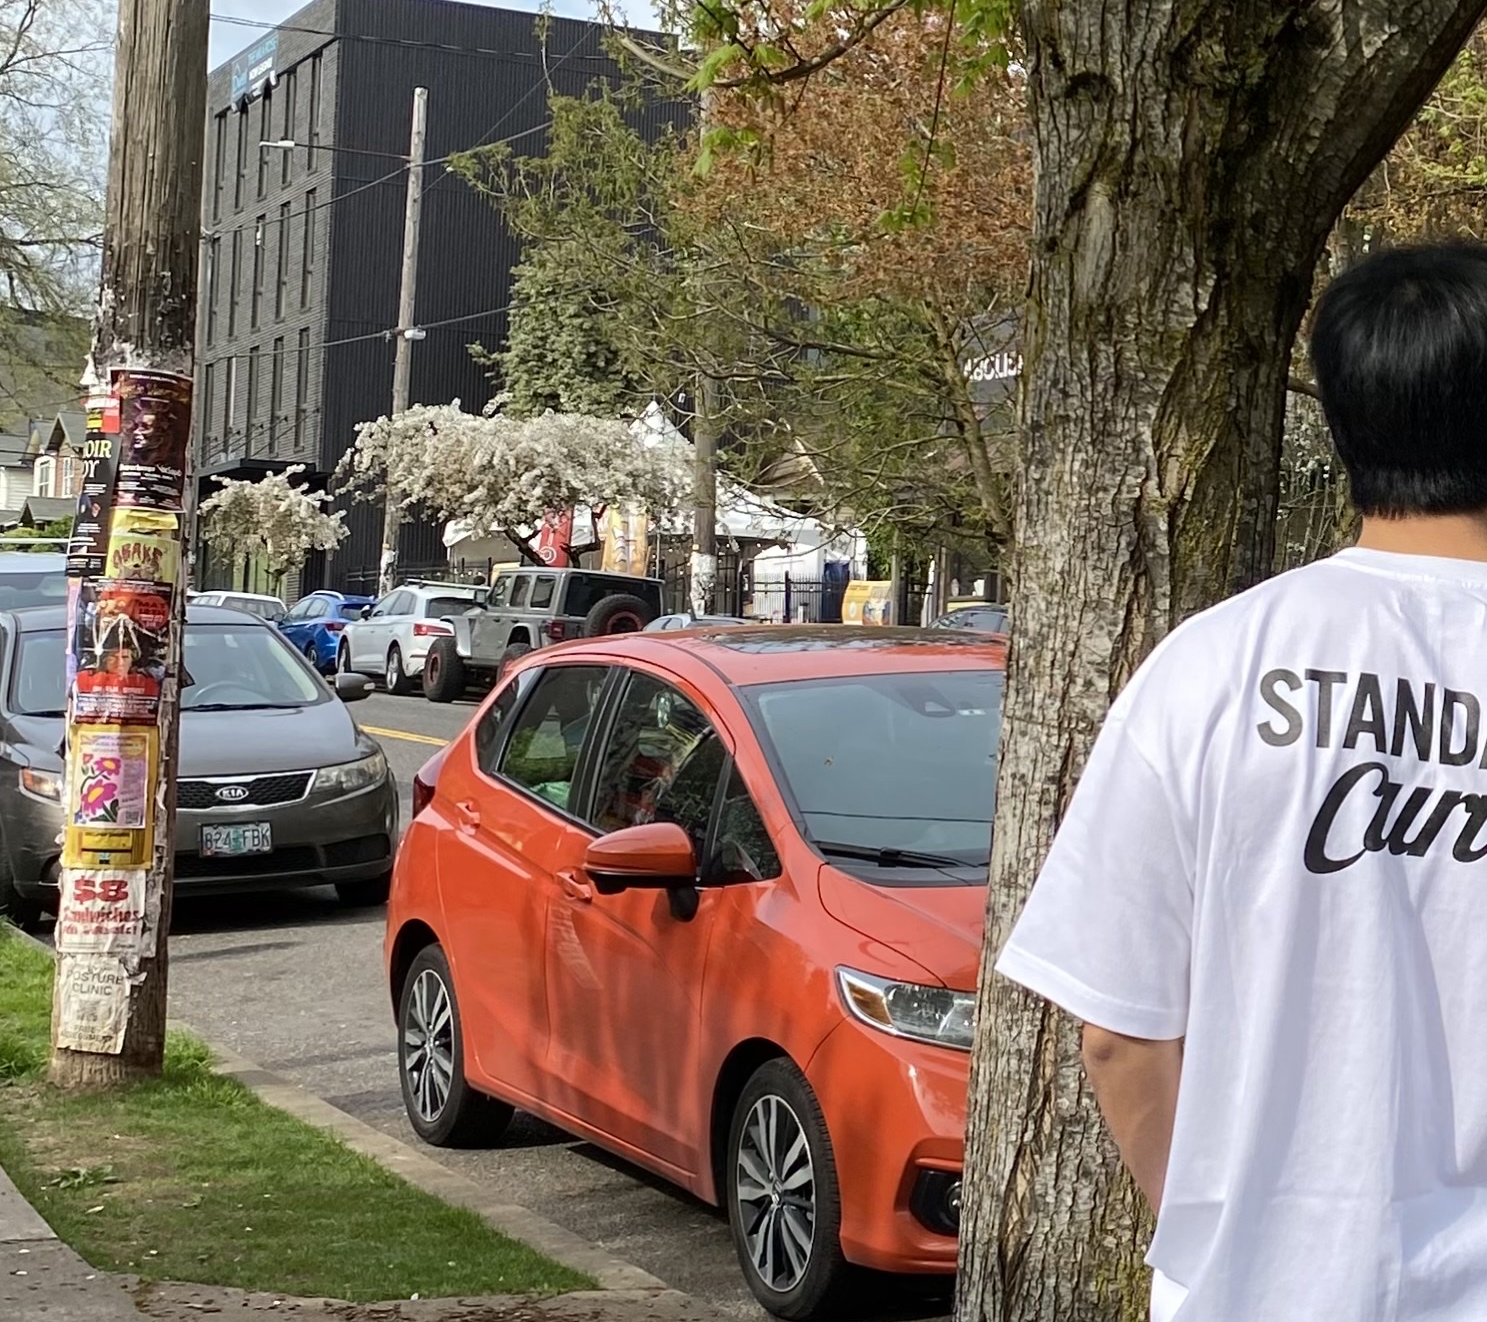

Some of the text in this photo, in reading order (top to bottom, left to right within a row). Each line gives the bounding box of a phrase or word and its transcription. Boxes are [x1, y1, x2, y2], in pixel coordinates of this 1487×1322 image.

[222, 789, 244, 797] KIA
[243, 828, 270, 847] FBK
[74, 875, 128, 905] $8
[67, 969, 123, 985] POSTURE
[72, 982, 112, 996] CLINIC
